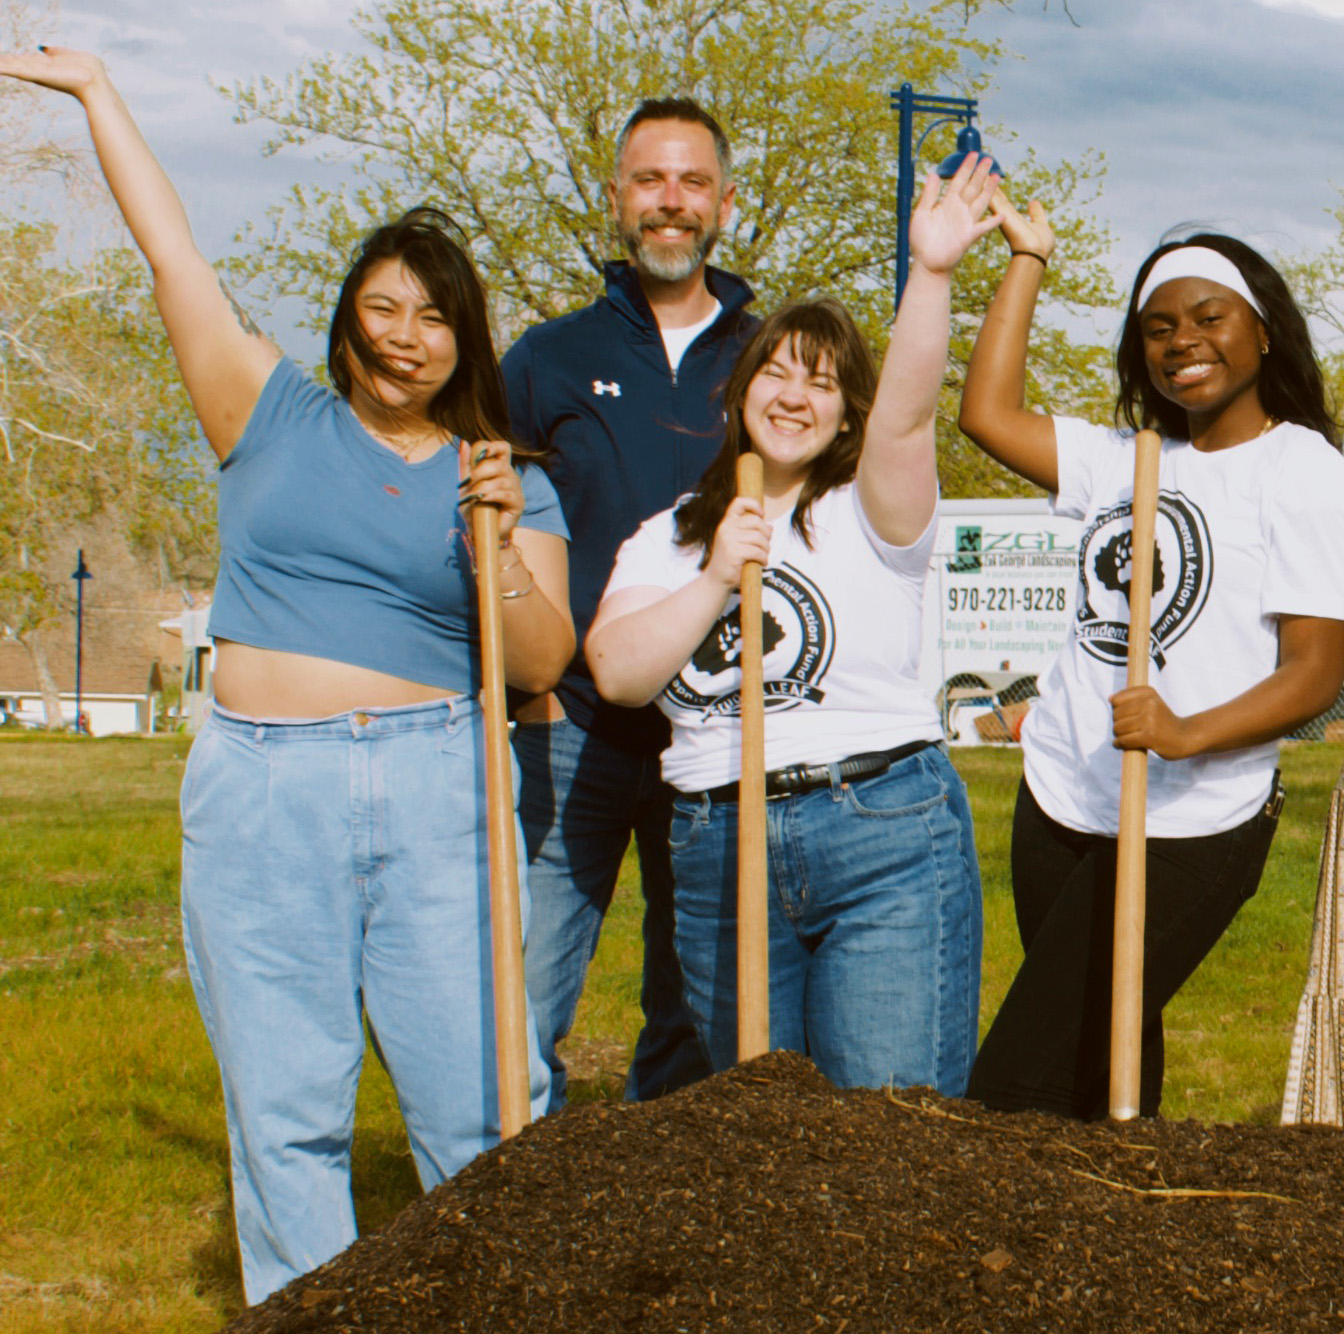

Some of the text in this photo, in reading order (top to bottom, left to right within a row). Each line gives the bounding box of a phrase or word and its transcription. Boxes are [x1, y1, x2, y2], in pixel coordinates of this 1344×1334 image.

[983, 530, 1076, 552] ZGL
[999, 554, 1026, 570] George
[1176, 561, 1197, 608] Action
[948, 587, 1066, 611] 970-221-9228
[798, 602, 819, 643] Action
[946, 620, 1067, 633] Design Build Maintain
[1075, 622, 1129, 641] Student
[1155, 607, 1182, 639] Fund
[954, 638, 966, 650] All
[969, 638, 987, 650] Your
[990, 638, 1045, 654] Landscaping
[796, 645, 820, 680] Fund
[769, 681, 812, 699] LEAF
